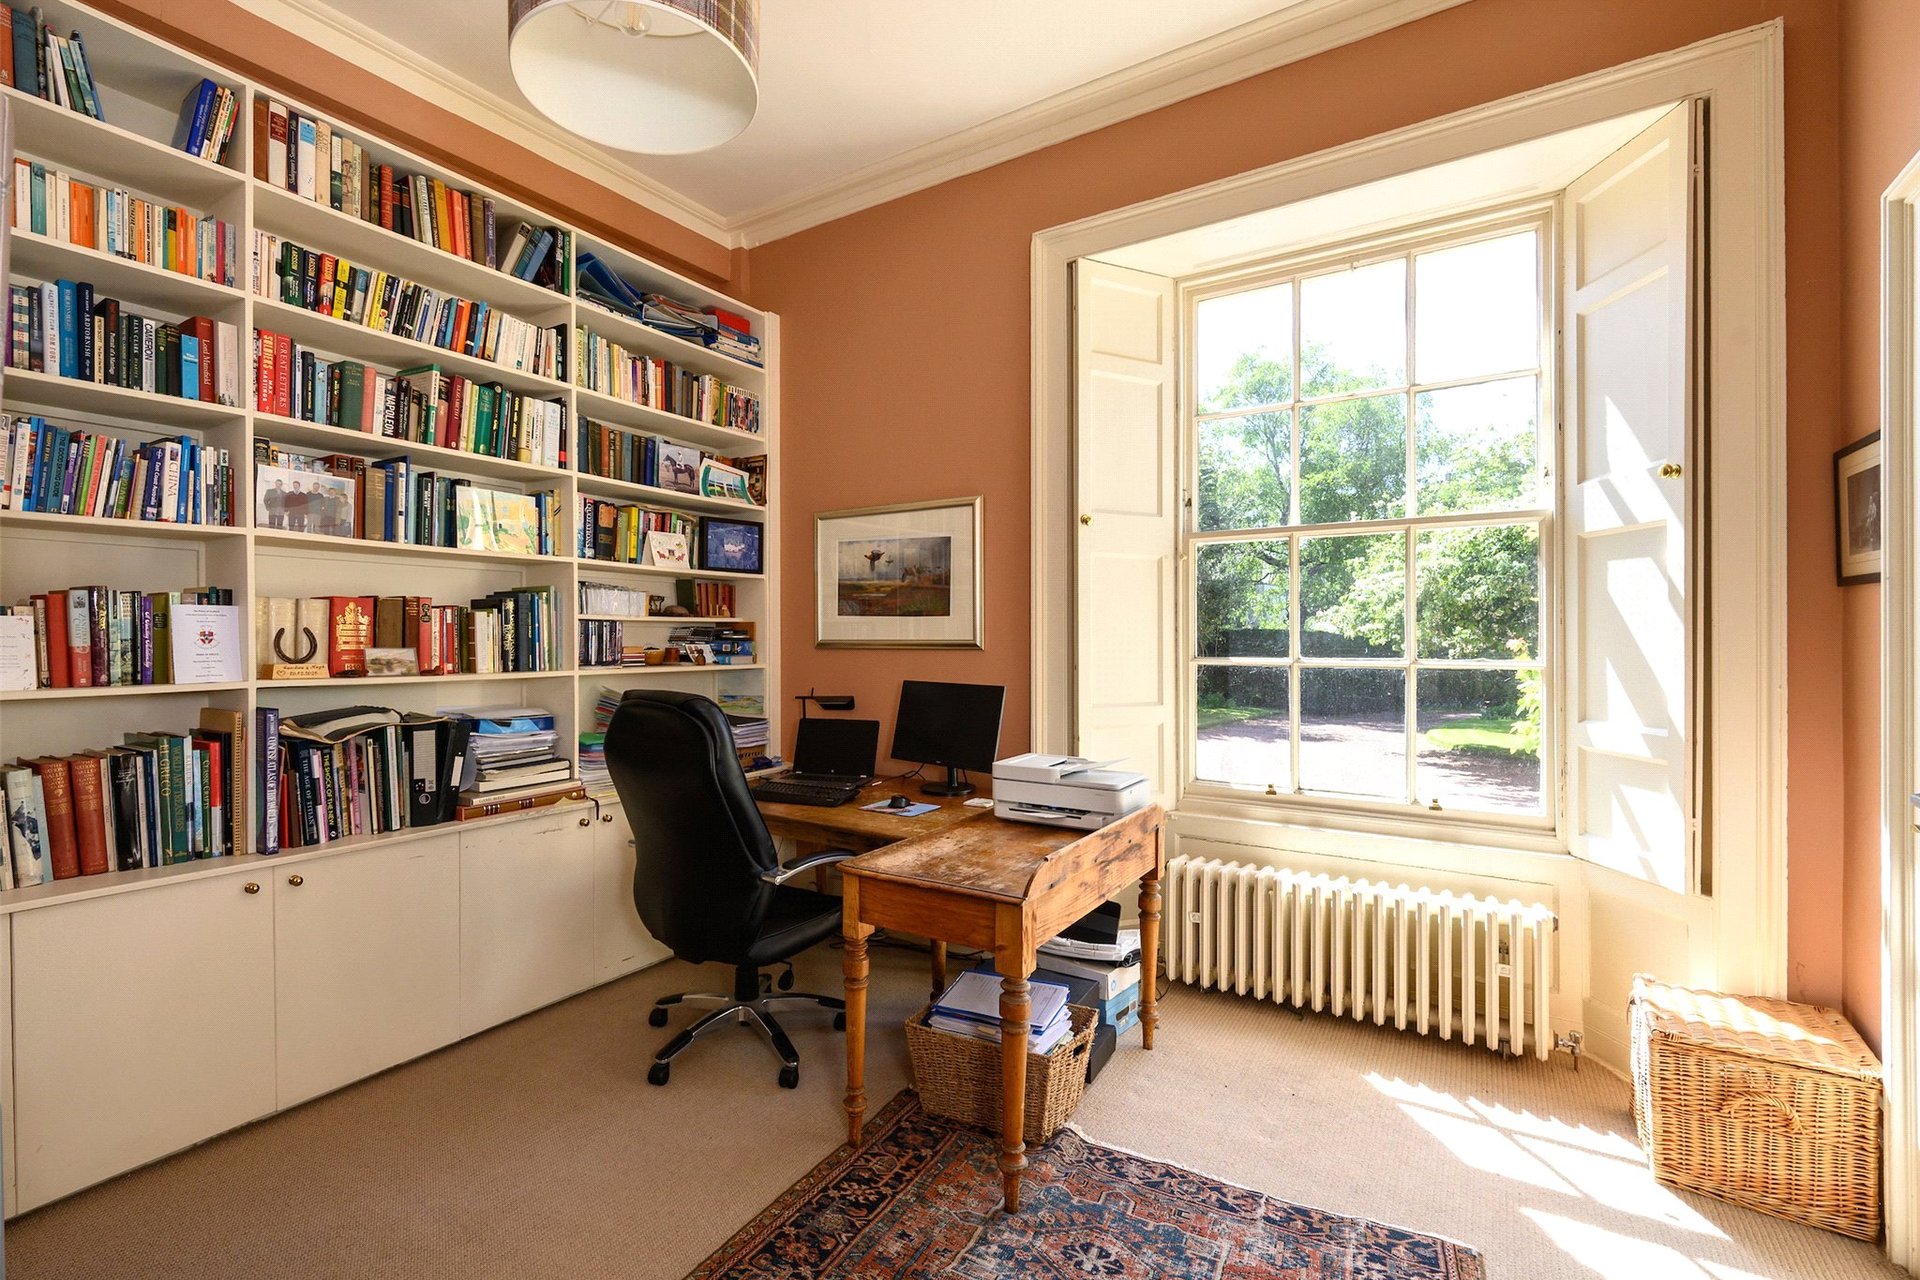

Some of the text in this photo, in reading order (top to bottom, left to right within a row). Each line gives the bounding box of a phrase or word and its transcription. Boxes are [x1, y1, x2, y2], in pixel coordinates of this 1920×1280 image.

[325, 258, 333, 281] LARSSON
[144, 324, 153, 361] CAMERON
[202, 339, 210, 354] Lord
[263, 335, 273, 370] SOLDIERS
[280, 342, 288, 408] GREAT LETTERS
[384, 394, 396, 436] NAPOLEON
[16, 444, 26, 472] MEXICO
[167, 462, 178, 497] CHINA
[79, 613, 87, 644] ZANZIBAR
[267, 736, 277, 760] CONCISE
[160, 745, 170, 796] EL GRECO
[174, 774, 183, 788] ART
[267, 762, 277, 781] ATLAS
[305, 790, 312, 800] OF
[326, 790, 332, 798] OF
[175, 789, 185, 832] TREASURES
[267, 801, 277, 822] WORLD
